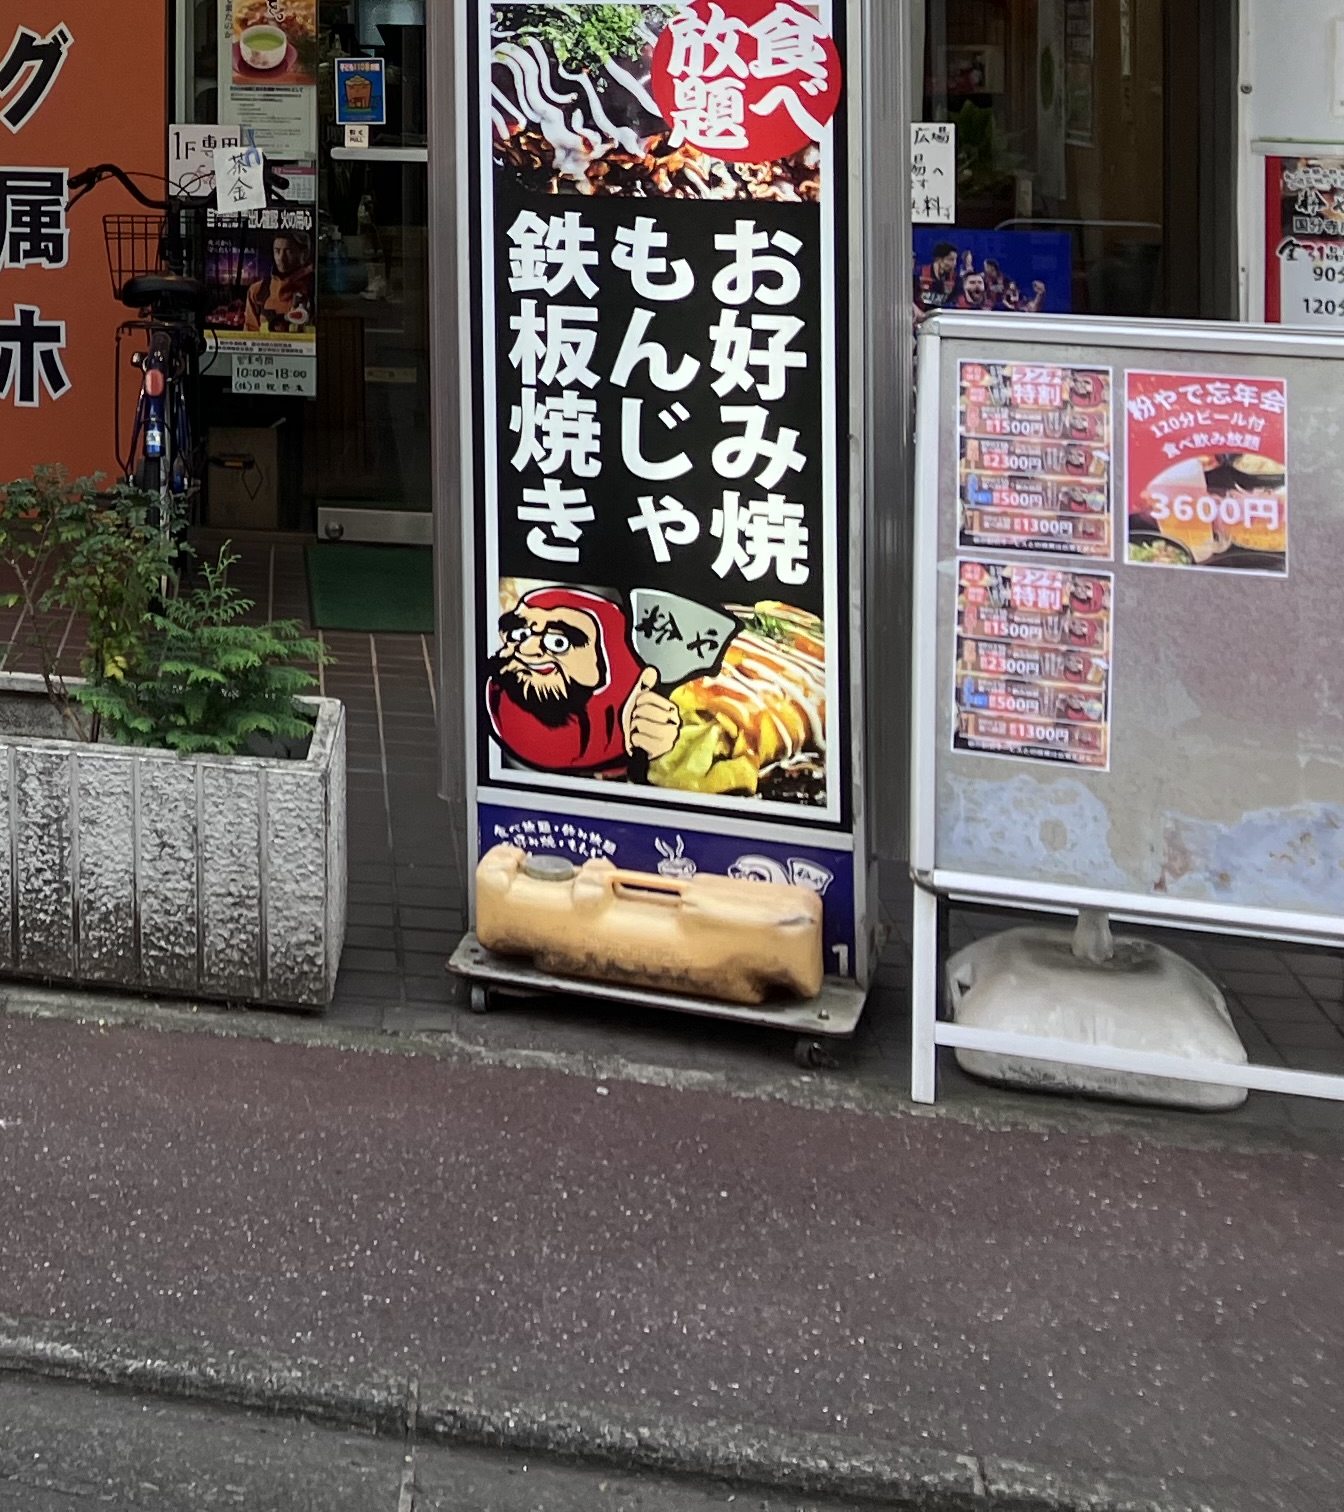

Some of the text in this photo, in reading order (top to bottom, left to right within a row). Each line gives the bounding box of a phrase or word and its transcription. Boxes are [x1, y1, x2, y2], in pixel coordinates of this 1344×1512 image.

[506, 209, 603, 564] 鉄板焼き
[610, 216, 701, 564] もんじゃ
[711, 220, 810, 586] お好み焼
[1128, 380, 1285, 422] 粉やで忘年会
[1150, 409, 1266, 439] 120分ビール付
[1162, 431, 1262, 459] 食べ飲み放題
[1150, 491, 1280, 531] 3600円
